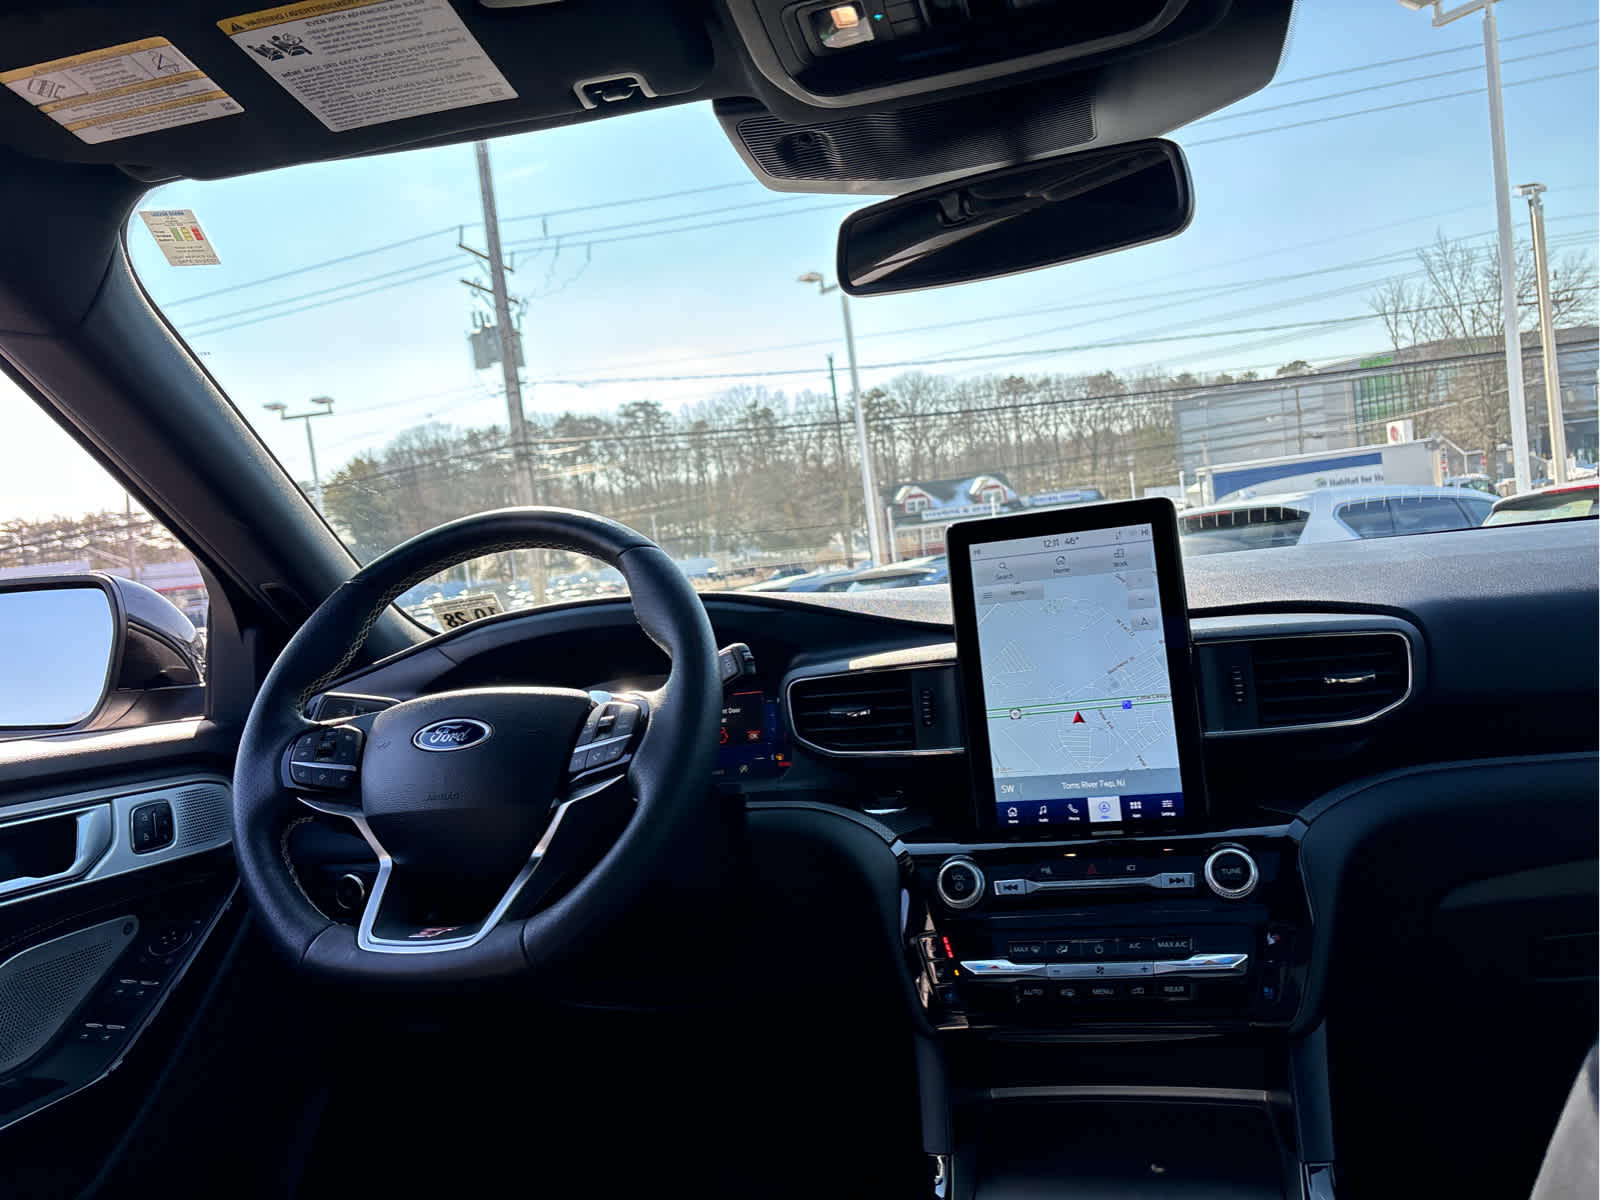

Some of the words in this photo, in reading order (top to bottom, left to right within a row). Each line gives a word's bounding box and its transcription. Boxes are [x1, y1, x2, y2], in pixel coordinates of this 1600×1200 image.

[1329, 476, 1359, 488] Habitat
[1360, 474, 1373, 483] for
[430, 725, 472, 744] Ford
[1080, 780, 1098, 789] River
[1000, 784, 1015, 794] SW
[1221, 867, 1242, 875] TUNE
[951, 873, 966, 881] VOL
[1013, 945, 1029, 953] MAX
[1163, 985, 1185, 993] REAR
